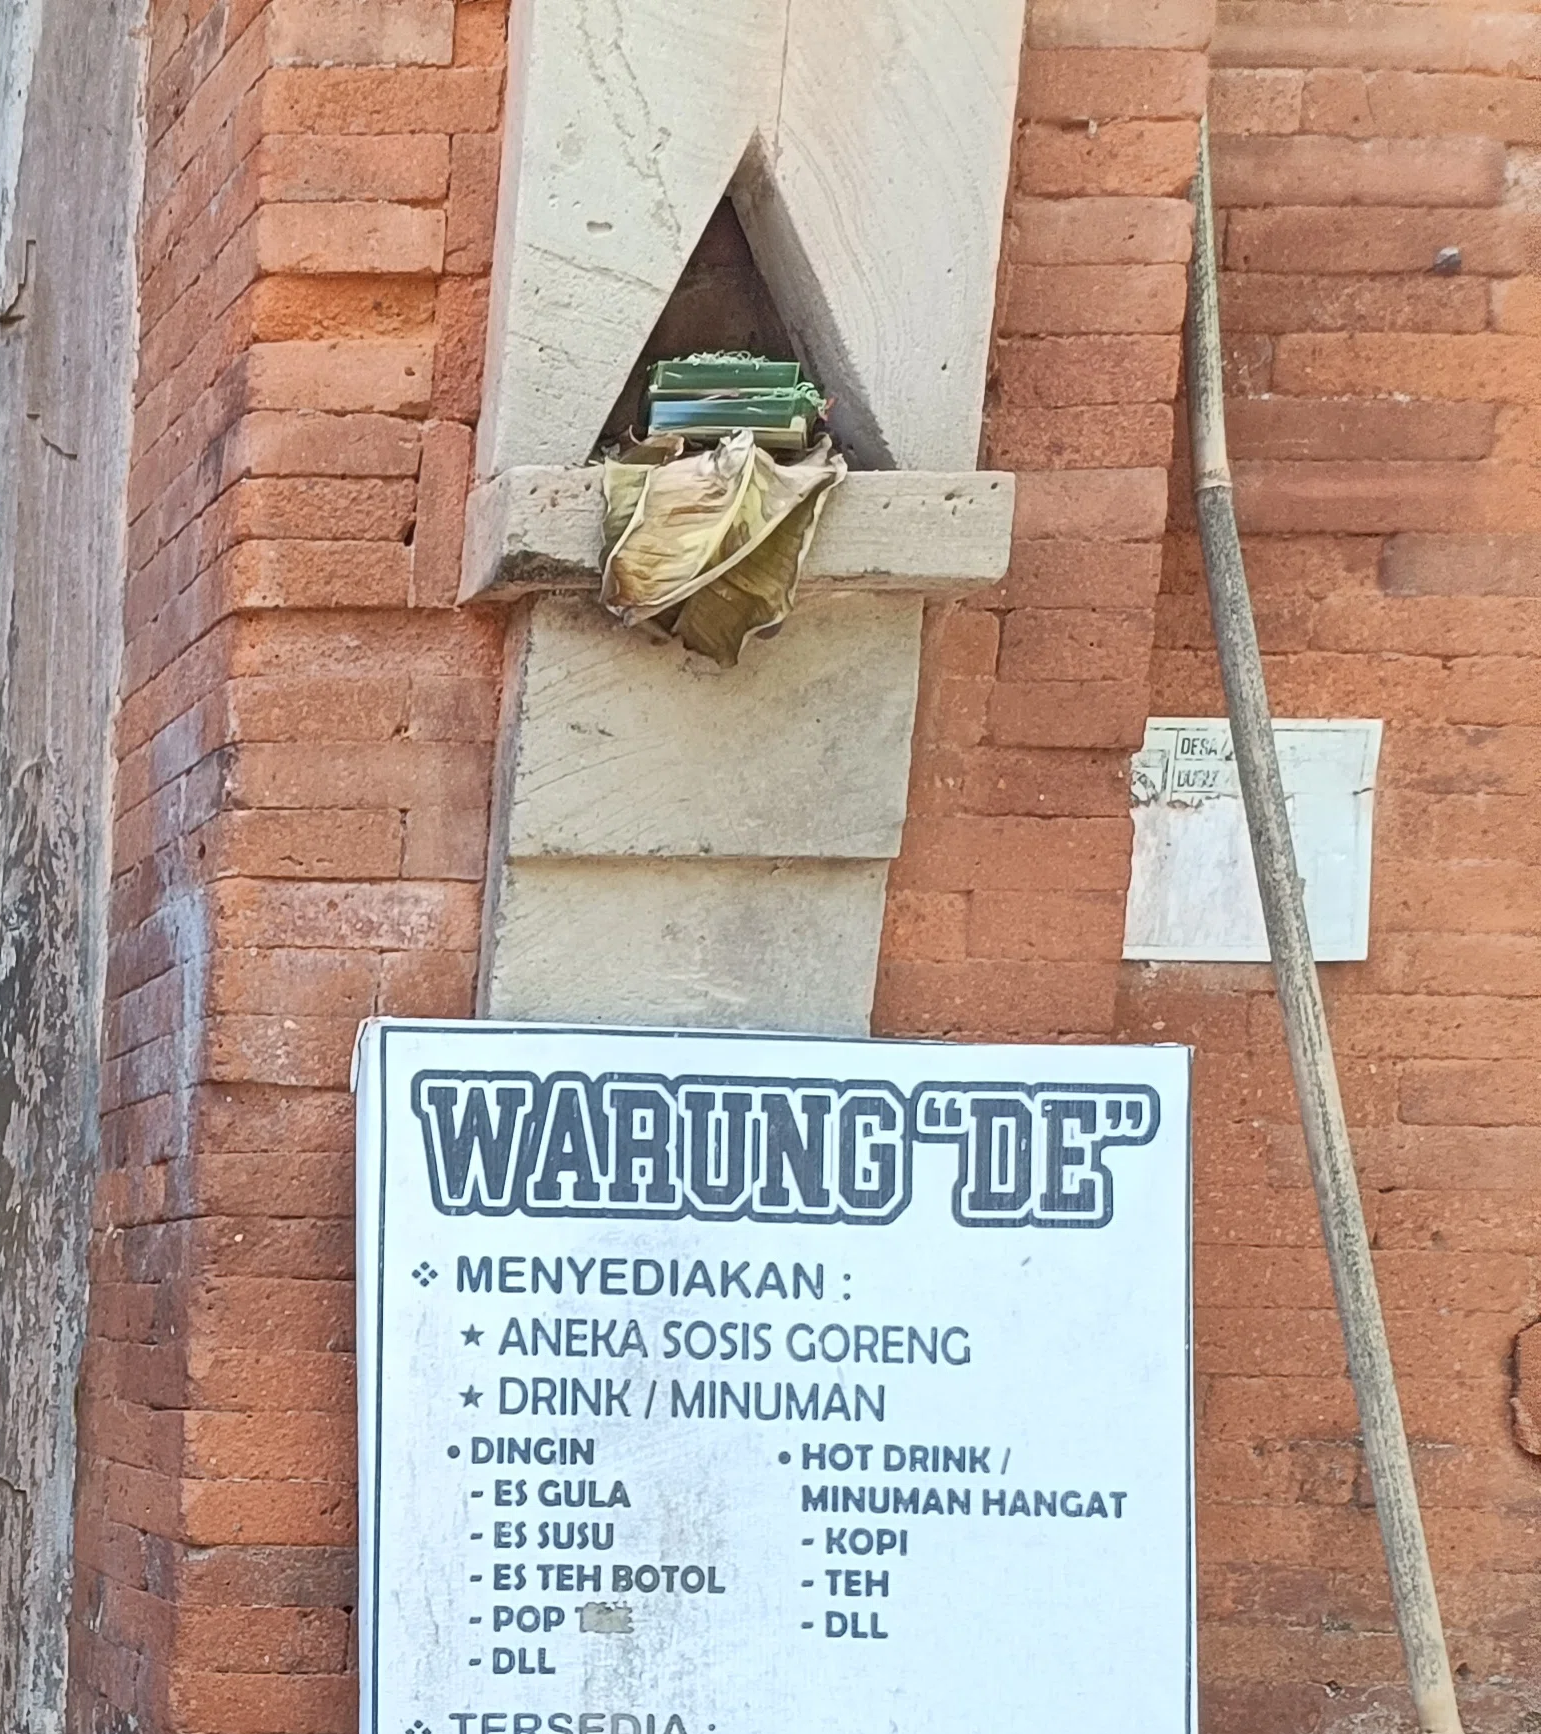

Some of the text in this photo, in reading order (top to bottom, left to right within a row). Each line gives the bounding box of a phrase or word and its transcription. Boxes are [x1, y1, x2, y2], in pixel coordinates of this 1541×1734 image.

[413, 1071, 909, 1223] WARUNG
[457, 1256, 824, 1300] MENYEDIAKAN
[498, 1317, 971, 1366] ANEKA SOSIS GORENG
[499, 1377, 631, 1417] DRINK
[671, 1379, 885, 1422] MINUMAN
[470, 1439, 595, 1466] DINGIN
[801, 1444, 874, 1472] HOT
[883, 1446, 992, 1474] DRINK
[492, 1480, 632, 1509] ES GULA
[802, 1489, 1128, 1519] MINUMAN HANGAT
[492, 1522, 615, 1550] ES SUSU
[825, 1528, 908, 1557] KOPI
[492, 1564, 726, 1597] ES TEH BOTOL
[825, 1569, 890, 1598] TEH
[492, 1604, 566, 1633] POP
[826, 1611, 889, 1640] DLL
[492, 1647, 557, 1675] DLL
